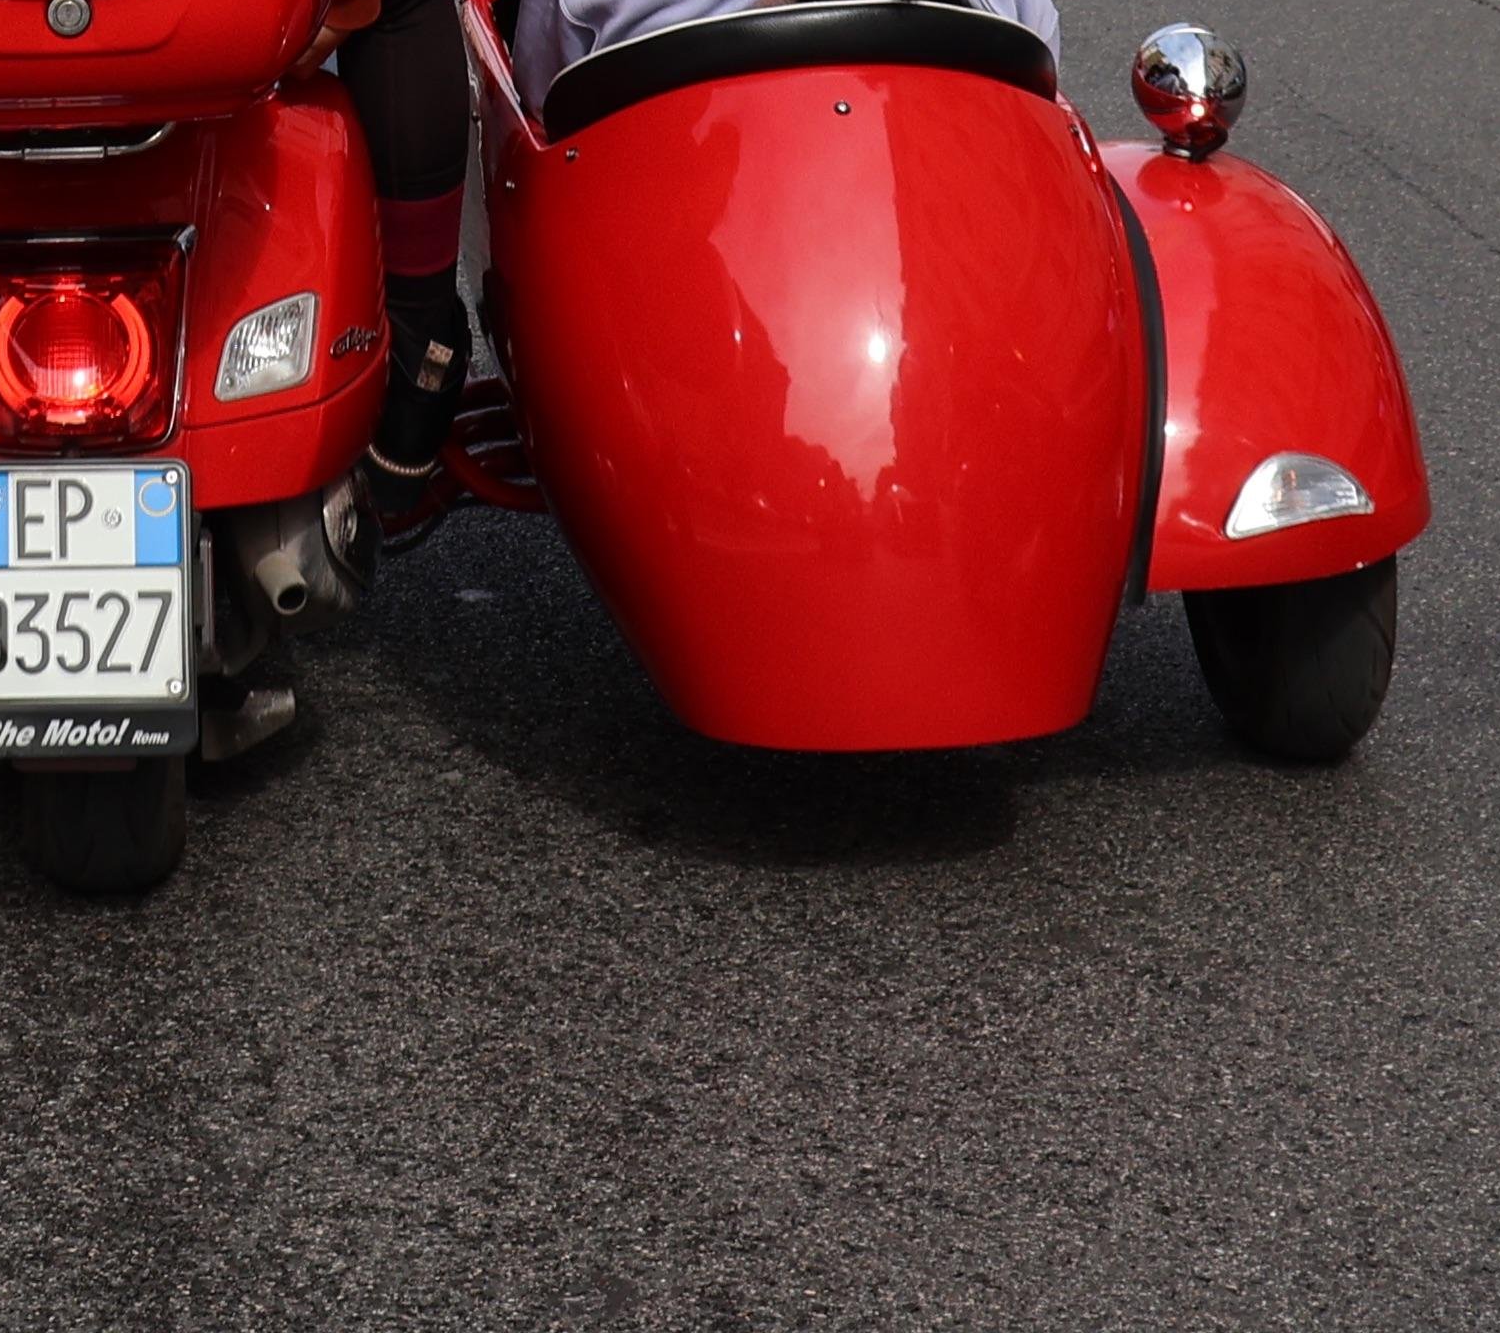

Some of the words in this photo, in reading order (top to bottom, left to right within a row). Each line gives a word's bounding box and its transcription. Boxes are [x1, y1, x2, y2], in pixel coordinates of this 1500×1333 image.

[15, 478, 93, 560] EP
[41, 715, 129, 747] Moto!
[131, 730, 170, 747] Roma
